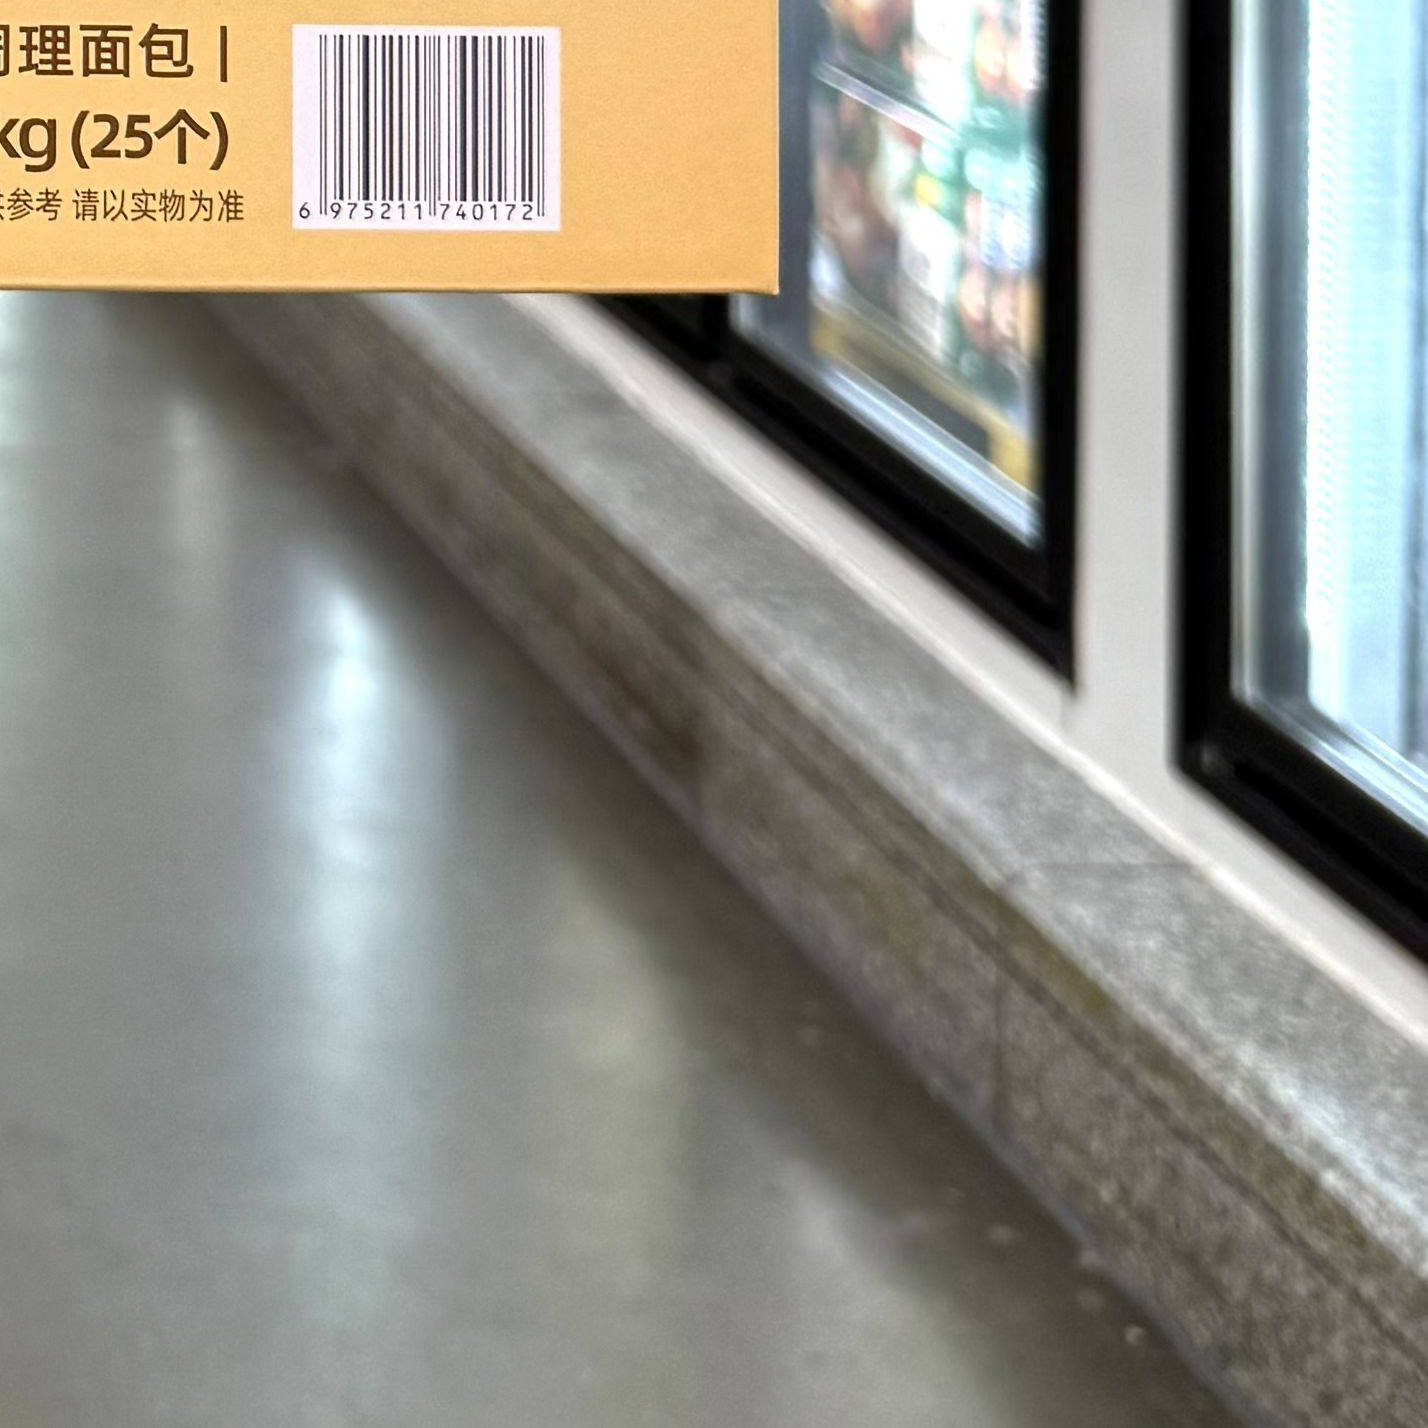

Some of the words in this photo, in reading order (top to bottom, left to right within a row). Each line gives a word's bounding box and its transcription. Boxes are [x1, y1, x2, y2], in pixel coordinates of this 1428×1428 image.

[72, 186, 246, 223] 请以实物为准
[297, 201, 312, 220] 6
[328, 201, 427, 221] 975211
[438, 201, 536, 221] 740172
